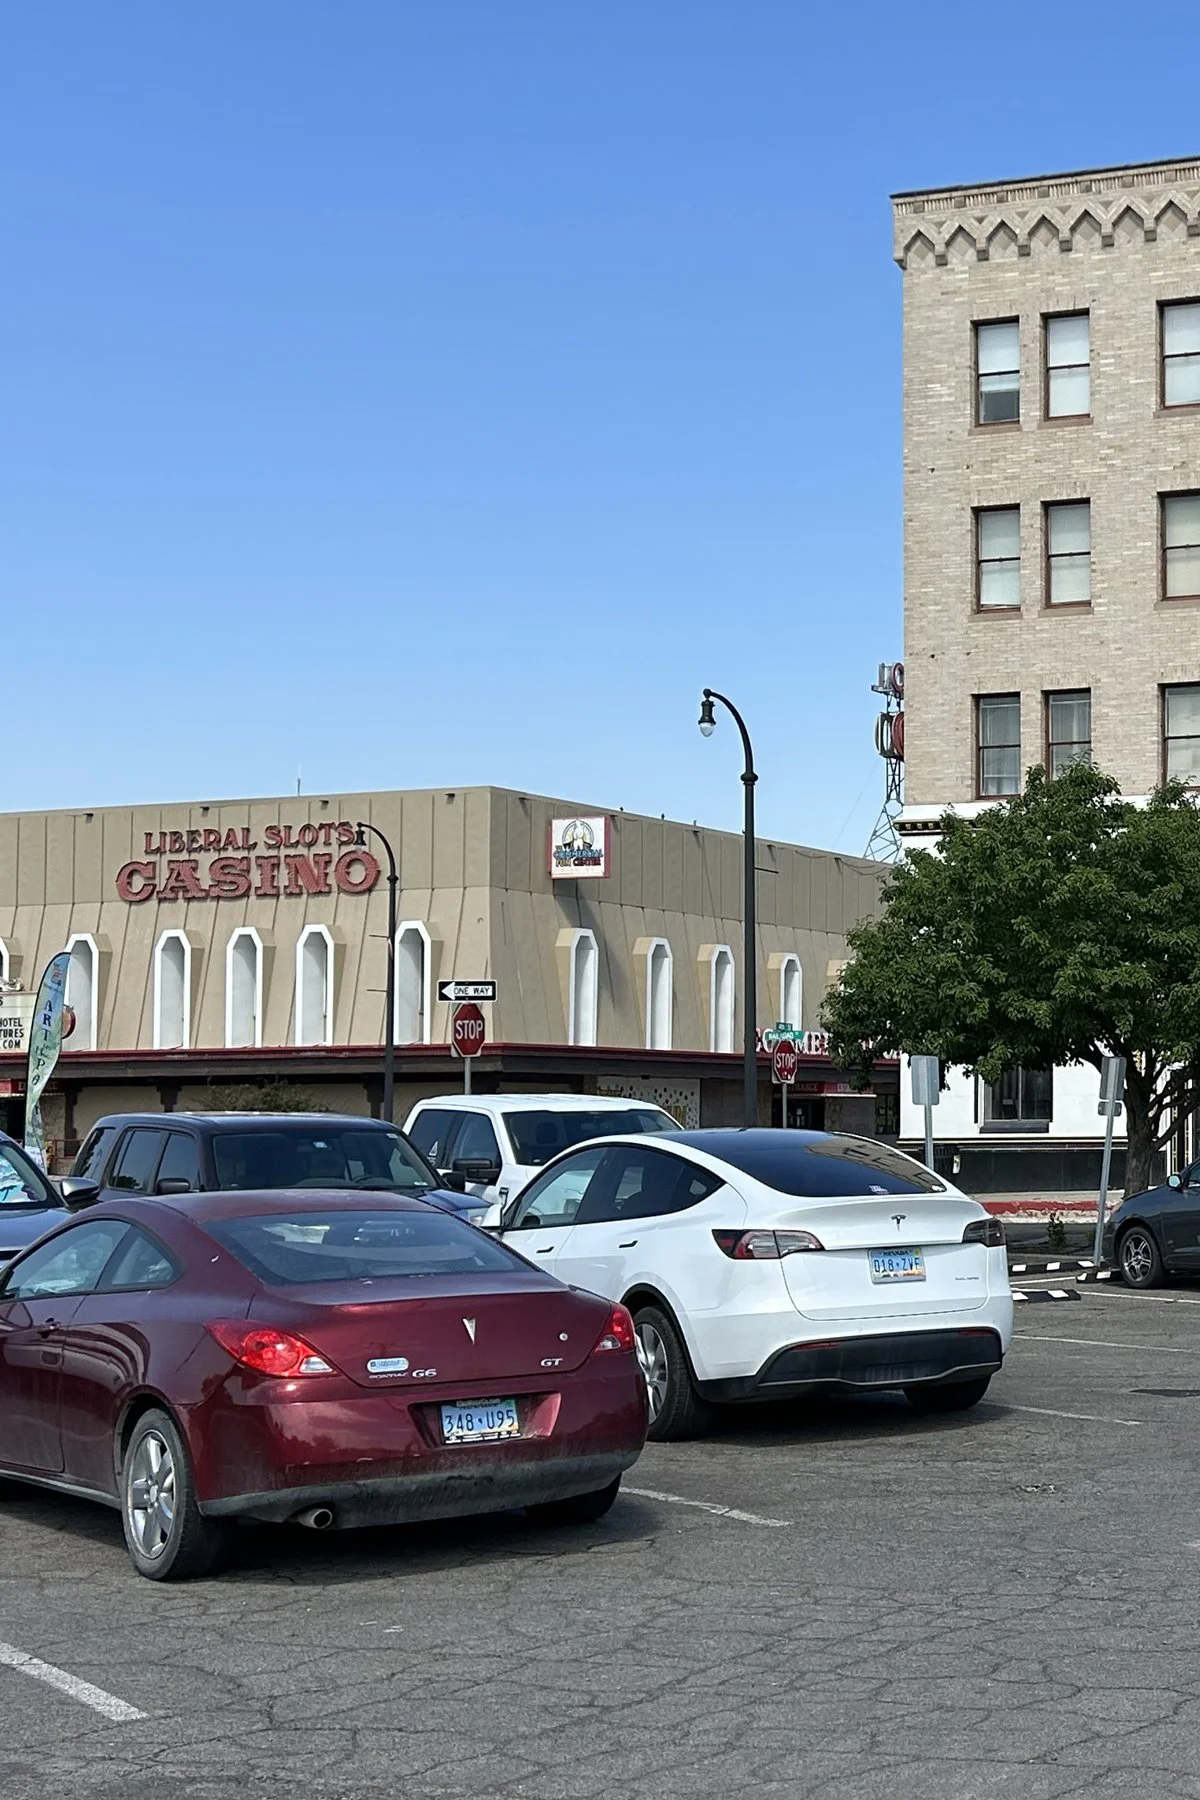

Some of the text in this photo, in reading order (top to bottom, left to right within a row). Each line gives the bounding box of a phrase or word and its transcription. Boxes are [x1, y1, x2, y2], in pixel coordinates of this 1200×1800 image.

[144, 821, 356, 854] LIBERAL SLOTS
[115, 850, 381, 902] CASINO
[454, 987, 490, 995] ONE WAY
[455, 1020, 483, 1040] STOP
[776, 1052, 796, 1068] STOP
[540, 1357, 563, 1366] GT
[411, 1368, 437, 1378] G6
